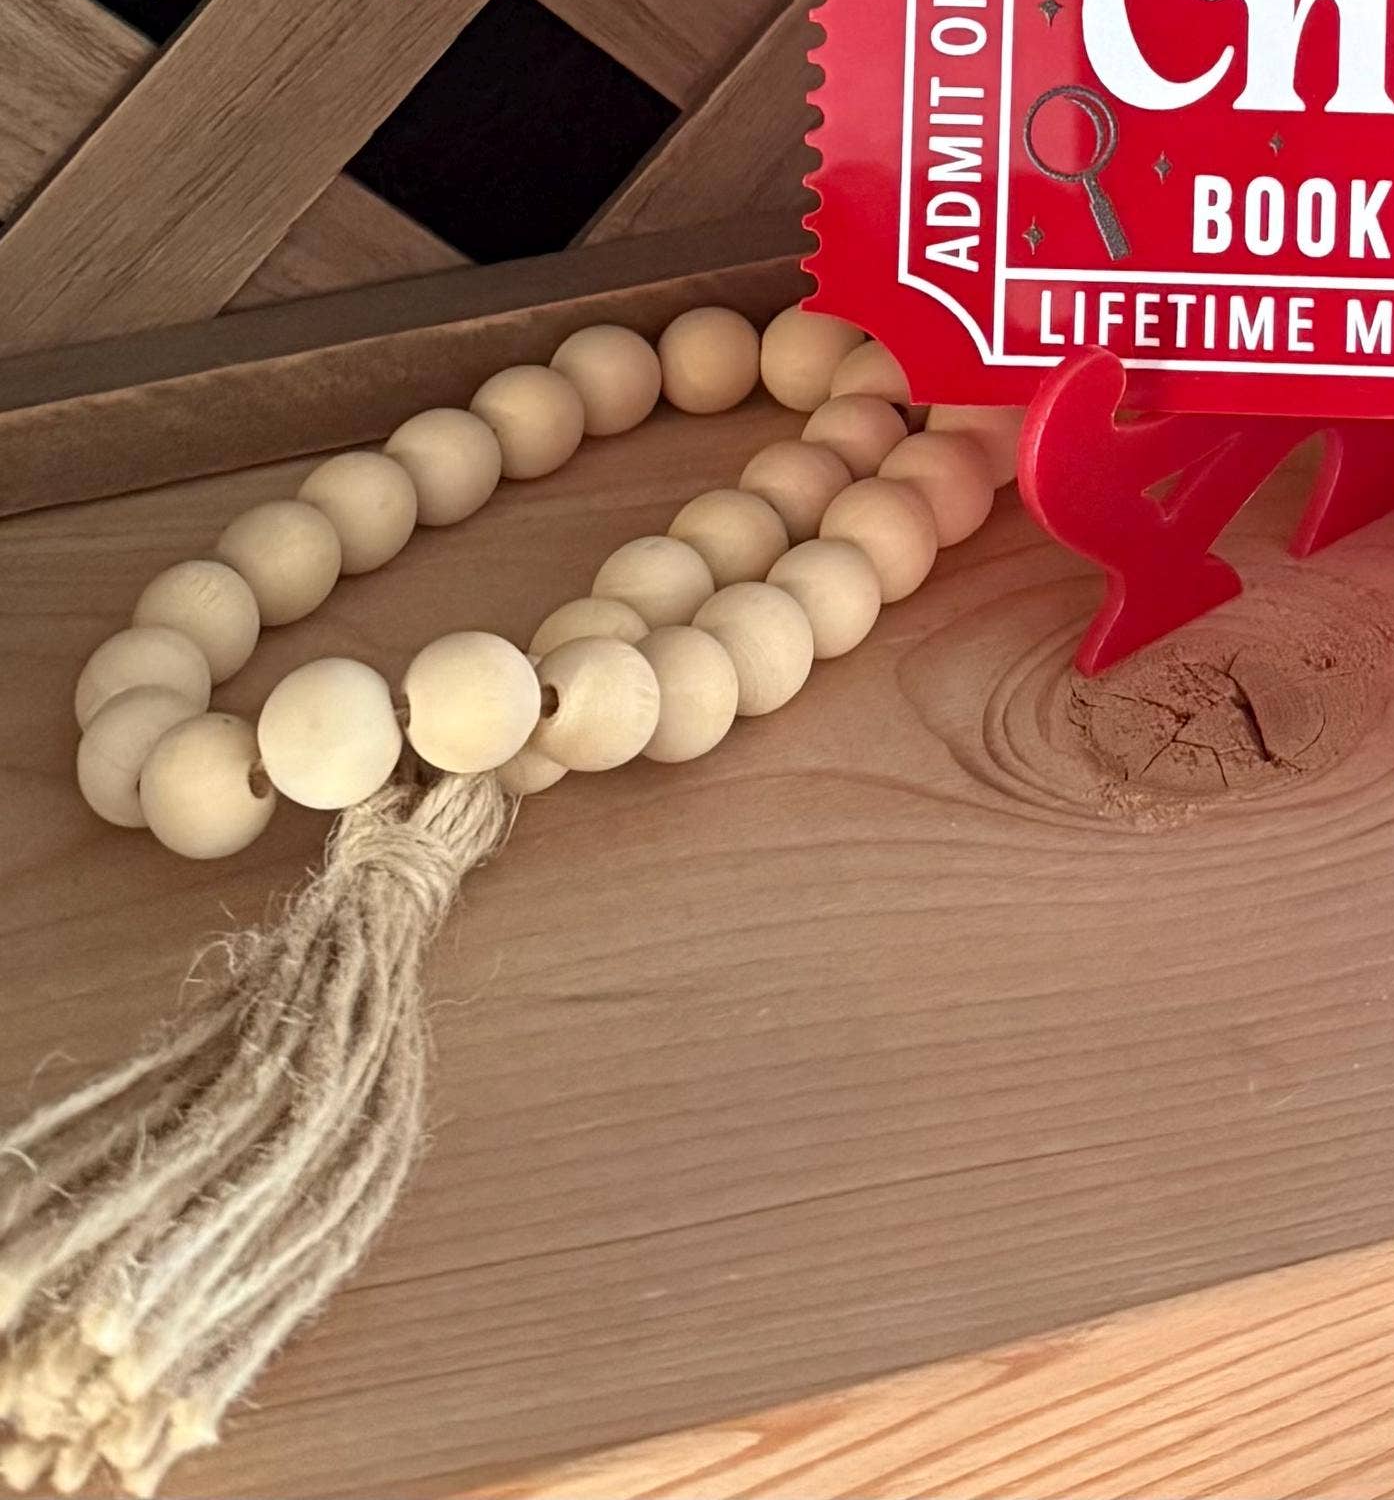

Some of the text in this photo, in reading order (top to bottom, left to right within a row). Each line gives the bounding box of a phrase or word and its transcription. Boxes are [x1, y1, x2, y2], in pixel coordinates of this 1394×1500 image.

[925, 73, 983, 273] ADMIT
[1194, 176, 1392, 259] BOOK
[1039, 288, 1316, 355] LIFETIME
